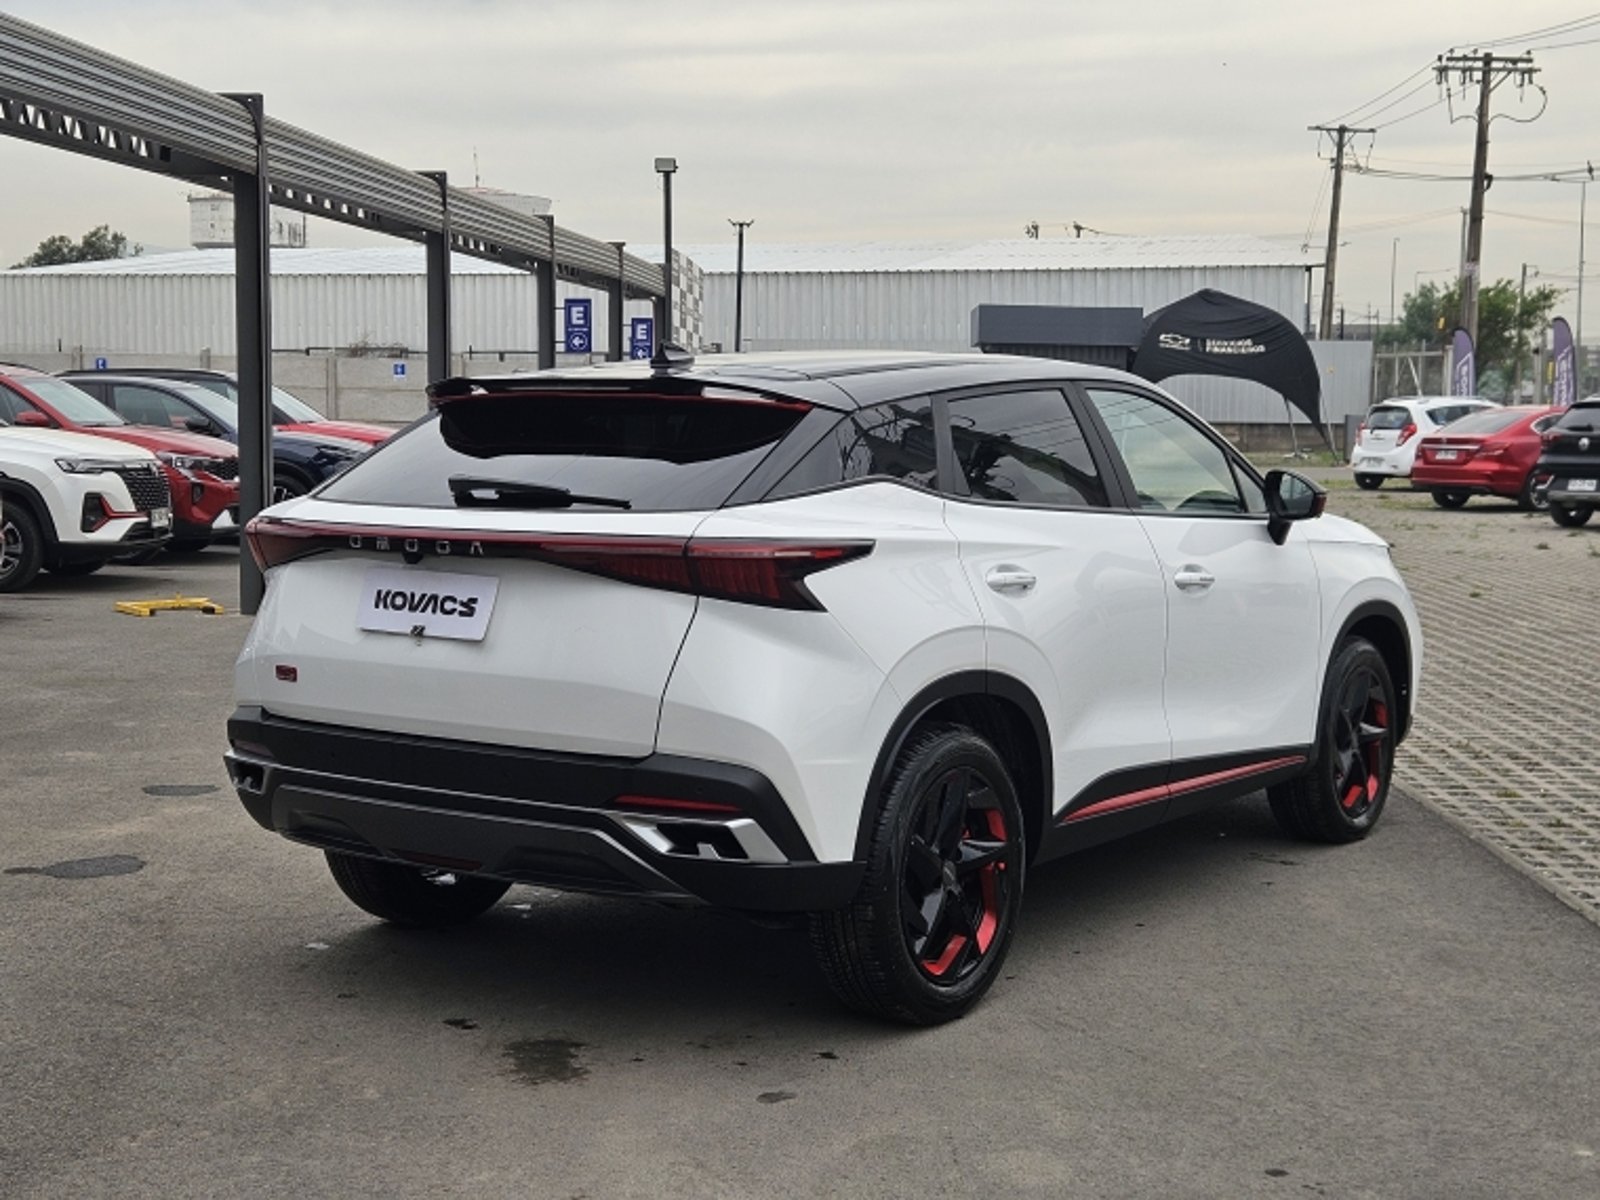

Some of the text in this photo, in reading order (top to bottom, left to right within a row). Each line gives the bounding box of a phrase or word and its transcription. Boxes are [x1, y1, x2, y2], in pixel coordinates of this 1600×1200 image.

[570, 306, 584, 325] E
[636, 323, 647, 340] E
[374, 588, 479, 618] KOVACS
